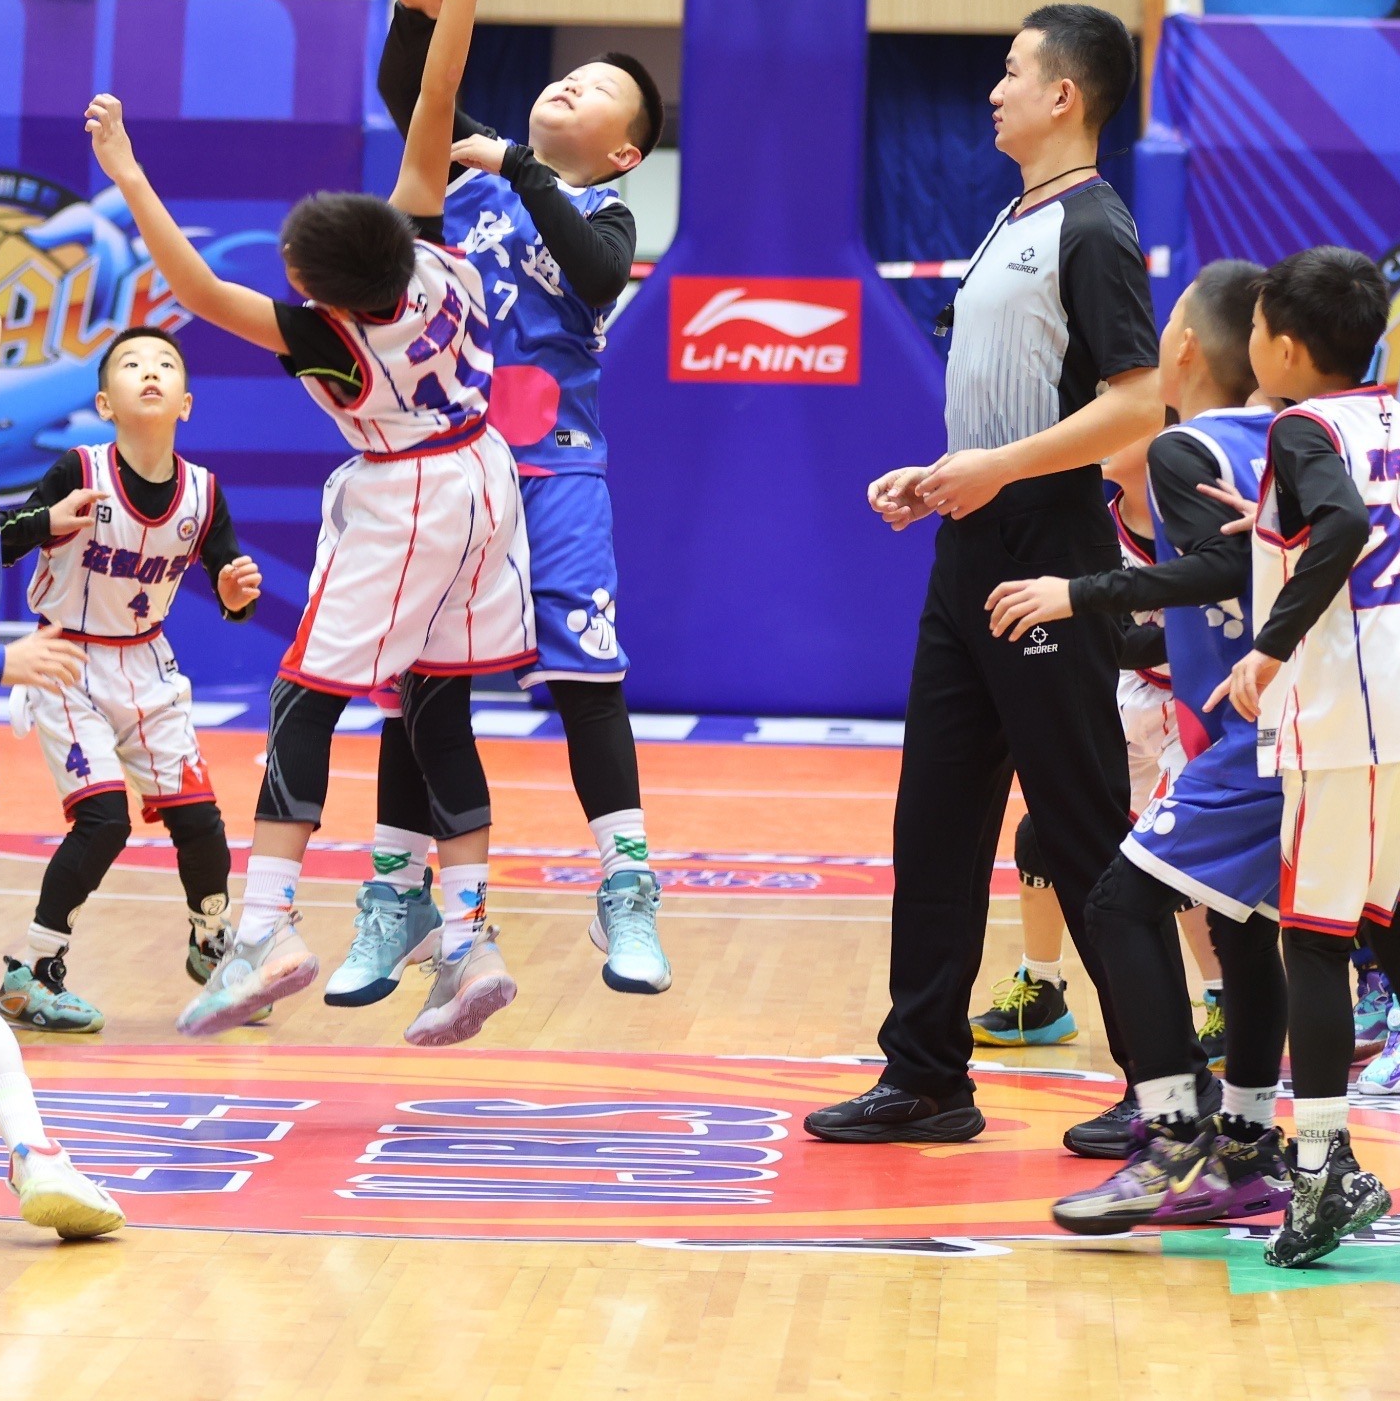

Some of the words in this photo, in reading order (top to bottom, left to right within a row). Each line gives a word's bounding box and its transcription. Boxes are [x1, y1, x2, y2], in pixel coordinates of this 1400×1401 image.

[1005, 262, 1039, 275] RIGORER
[493, 279, 519, 321] 7
[681, 343, 848, 374] LI-NING
[127, 592, 151, 618] 4
[591, 616, 611, 652] 7
[1023, 643, 1059, 657] RIGORER
[65, 742, 91, 778] 4
[333, 1097, 793, 1205] WJBLS
